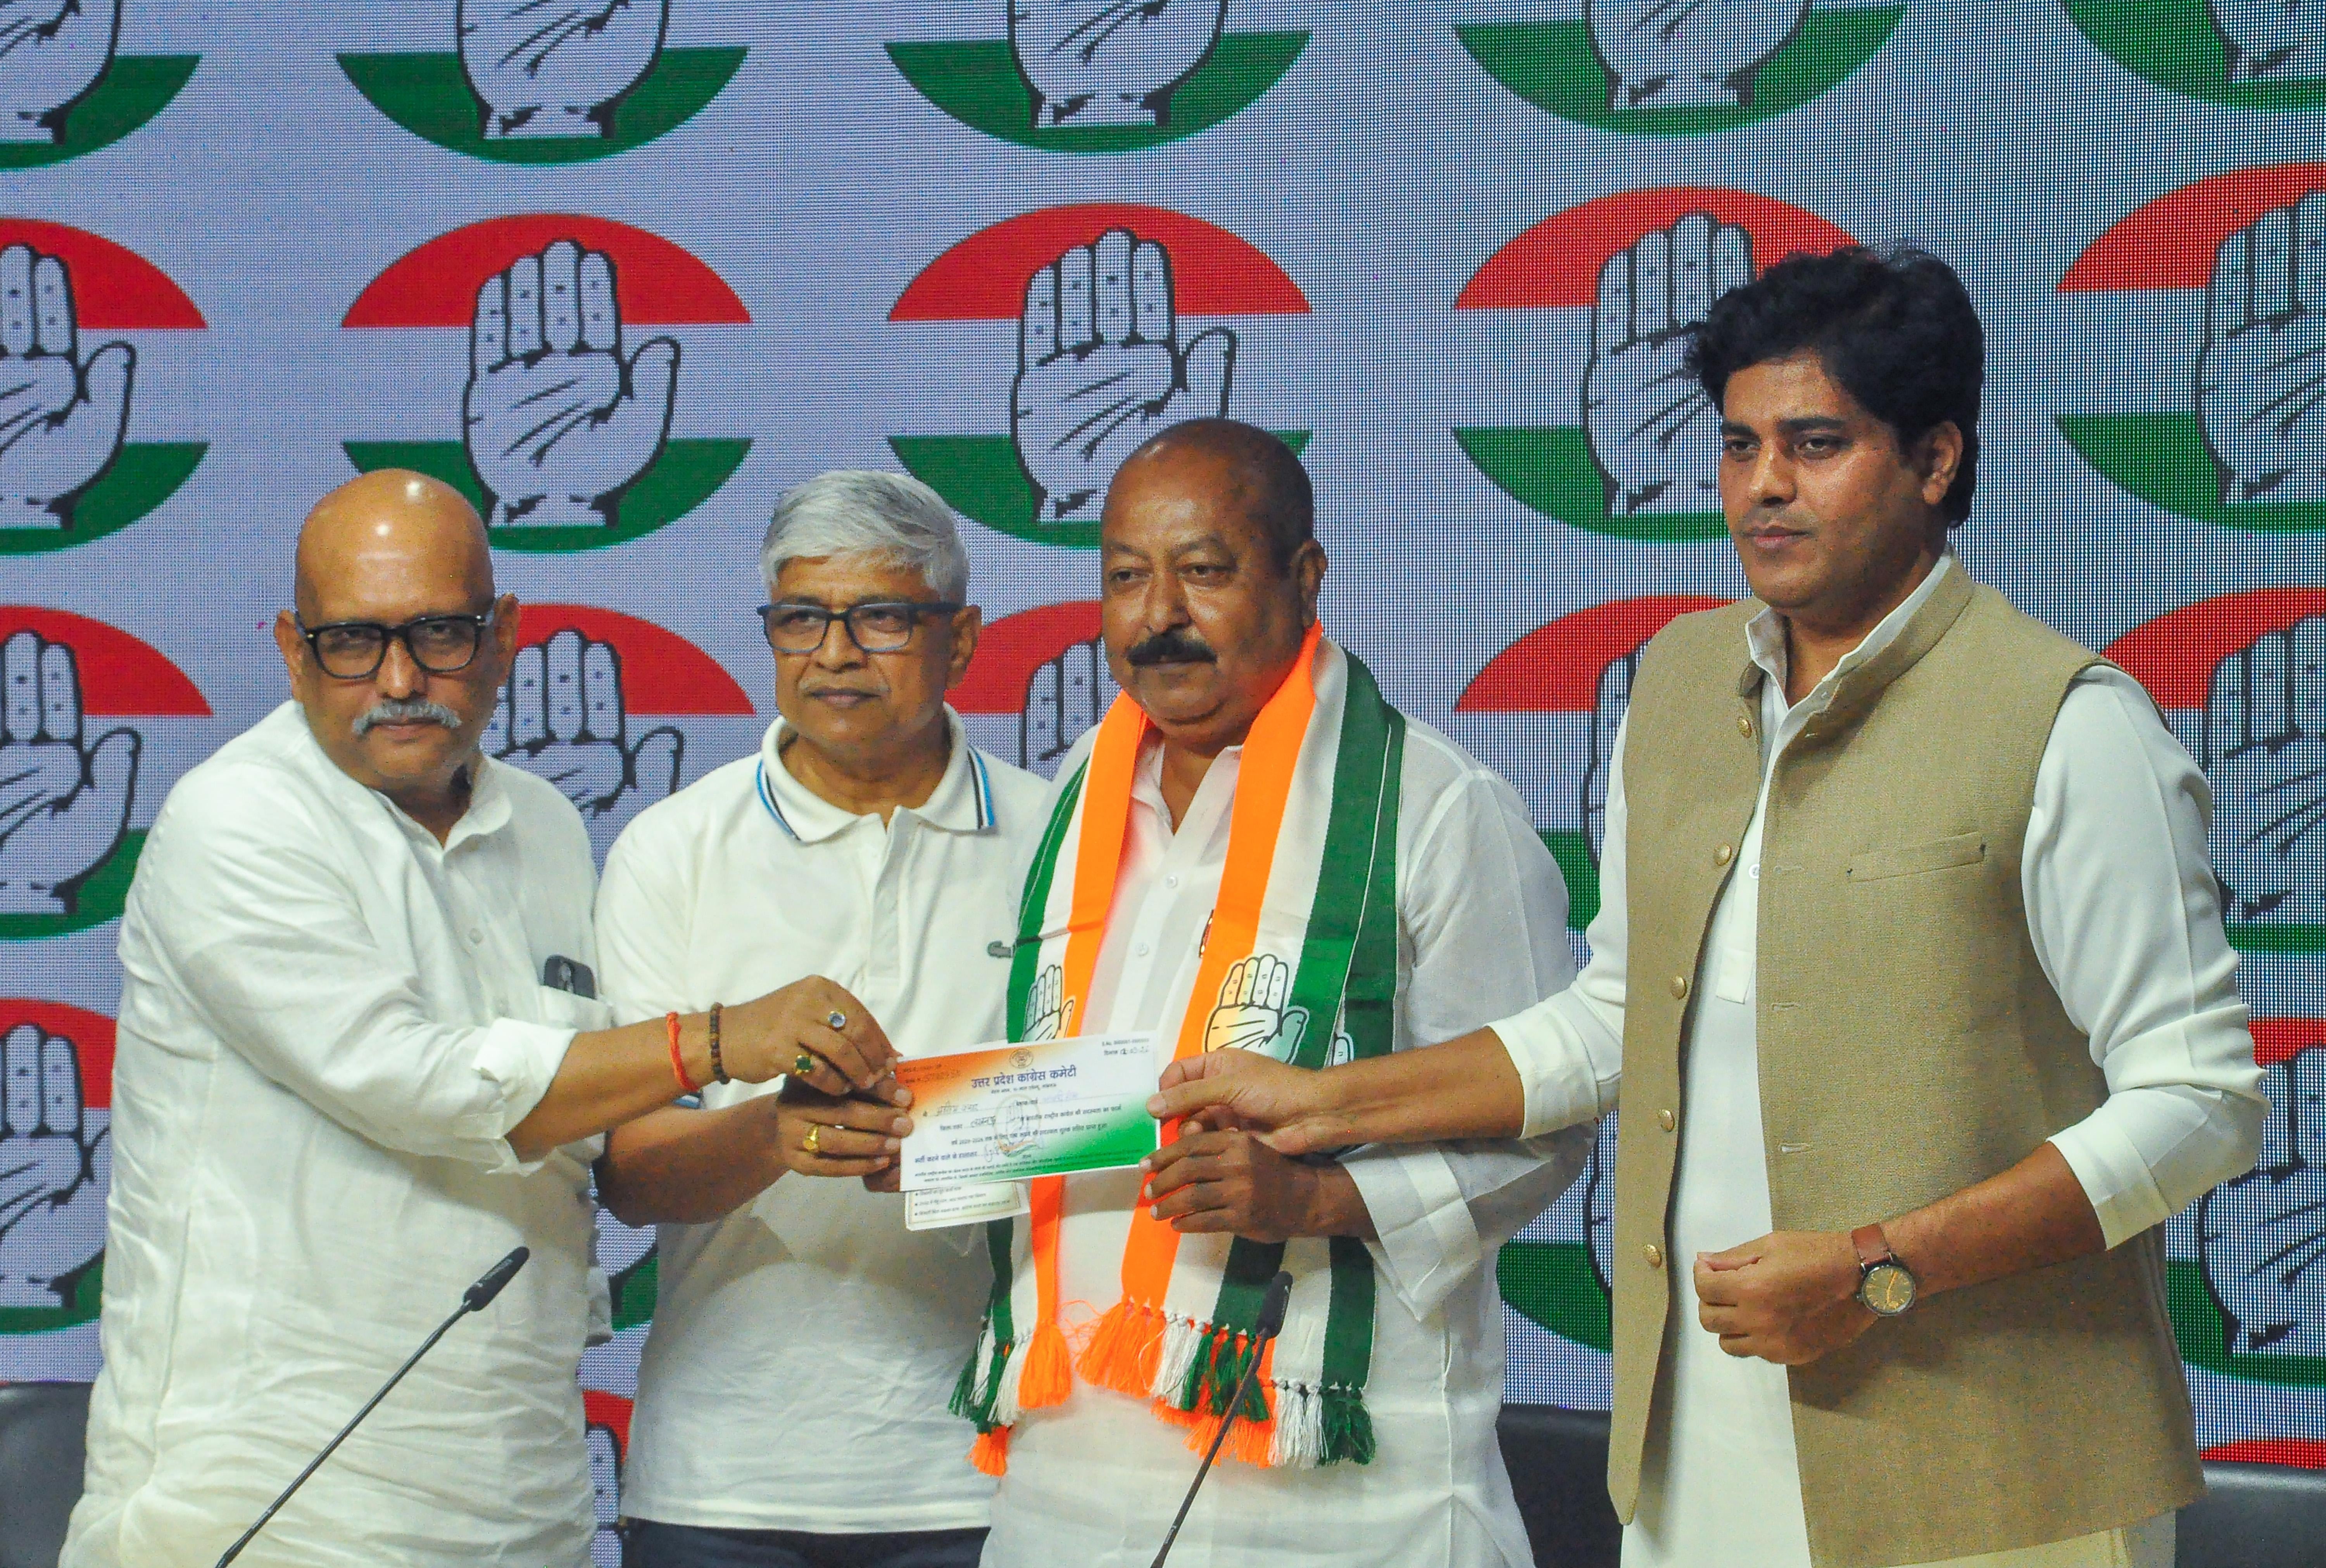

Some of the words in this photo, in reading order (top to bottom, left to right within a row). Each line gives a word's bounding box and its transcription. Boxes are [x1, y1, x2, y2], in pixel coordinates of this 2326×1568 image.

[971, 1078, 990, 1088] उत्तर
[994, 1072, 1014, 1086] प्रदेश
[1018, 1068, 1046, 1082] कांग्रेस
[1050, 1064, 1077, 1078] कमेटी
